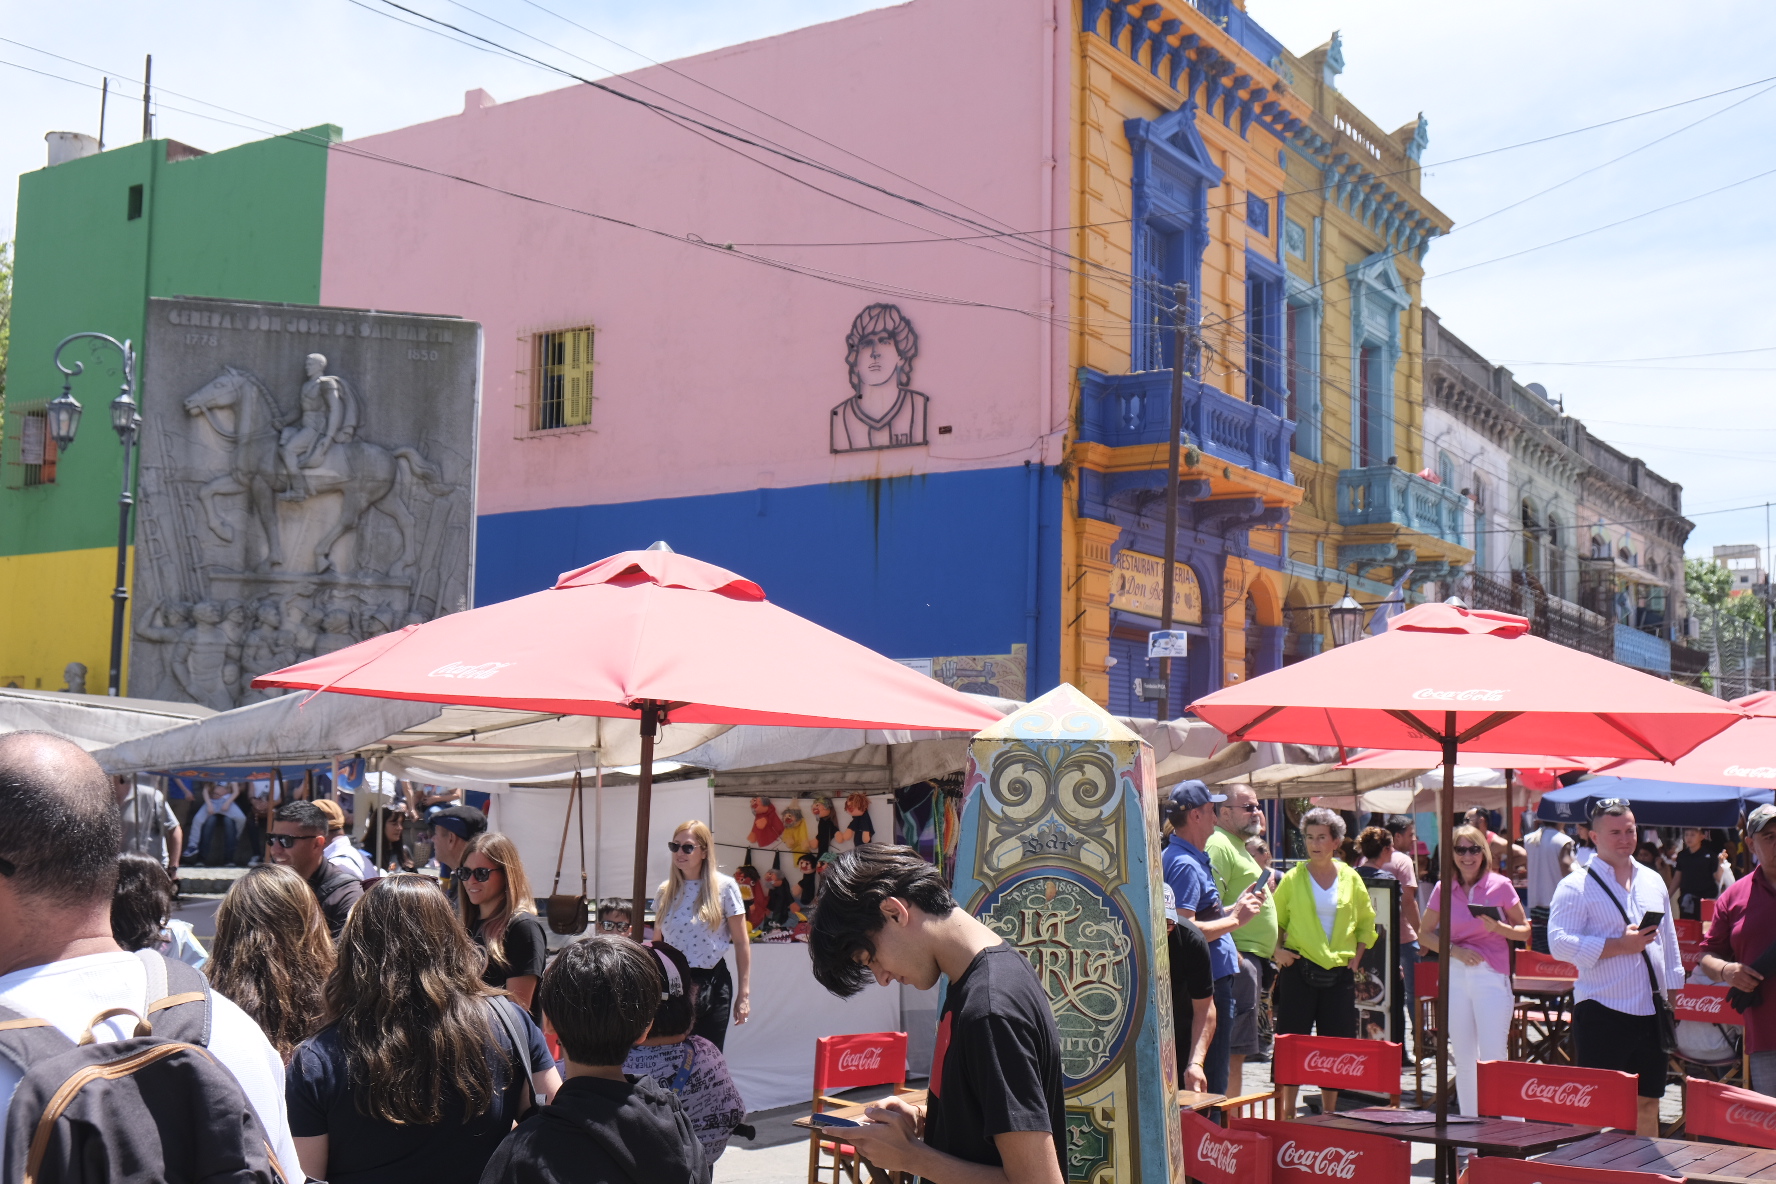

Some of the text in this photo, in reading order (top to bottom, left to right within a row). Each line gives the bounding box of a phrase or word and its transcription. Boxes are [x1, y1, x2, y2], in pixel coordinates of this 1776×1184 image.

[168, 309, 453, 343] GENERAL DON JOSE DE SAN MARTIN
[184, 333, 218, 347] 1778
[407, 348, 438, 361] 1850
[1117, 553, 1160, 577] RESTAURANT
[1126, 575, 1147, 597] Don
[1412, 688, 1507, 702] Coca-Cola
[1723, 765, 1776, 779] Coca-Col
[1022, 834, 1079, 857] Bar
[1007, 879, 1083, 902] Desd 1882
[838, 1047, 883, 1072] Coca-Cola
[1304, 1050, 1368, 1076] Coca-Cola
[1521, 1078, 1595, 1108] Coca-Cola
[1726, 1103, 1776, 1131] Coca-C
[1197, 1132, 1241, 1175] Coca-Cola
[1277, 1141, 1360, 1180] Coca-Cola
